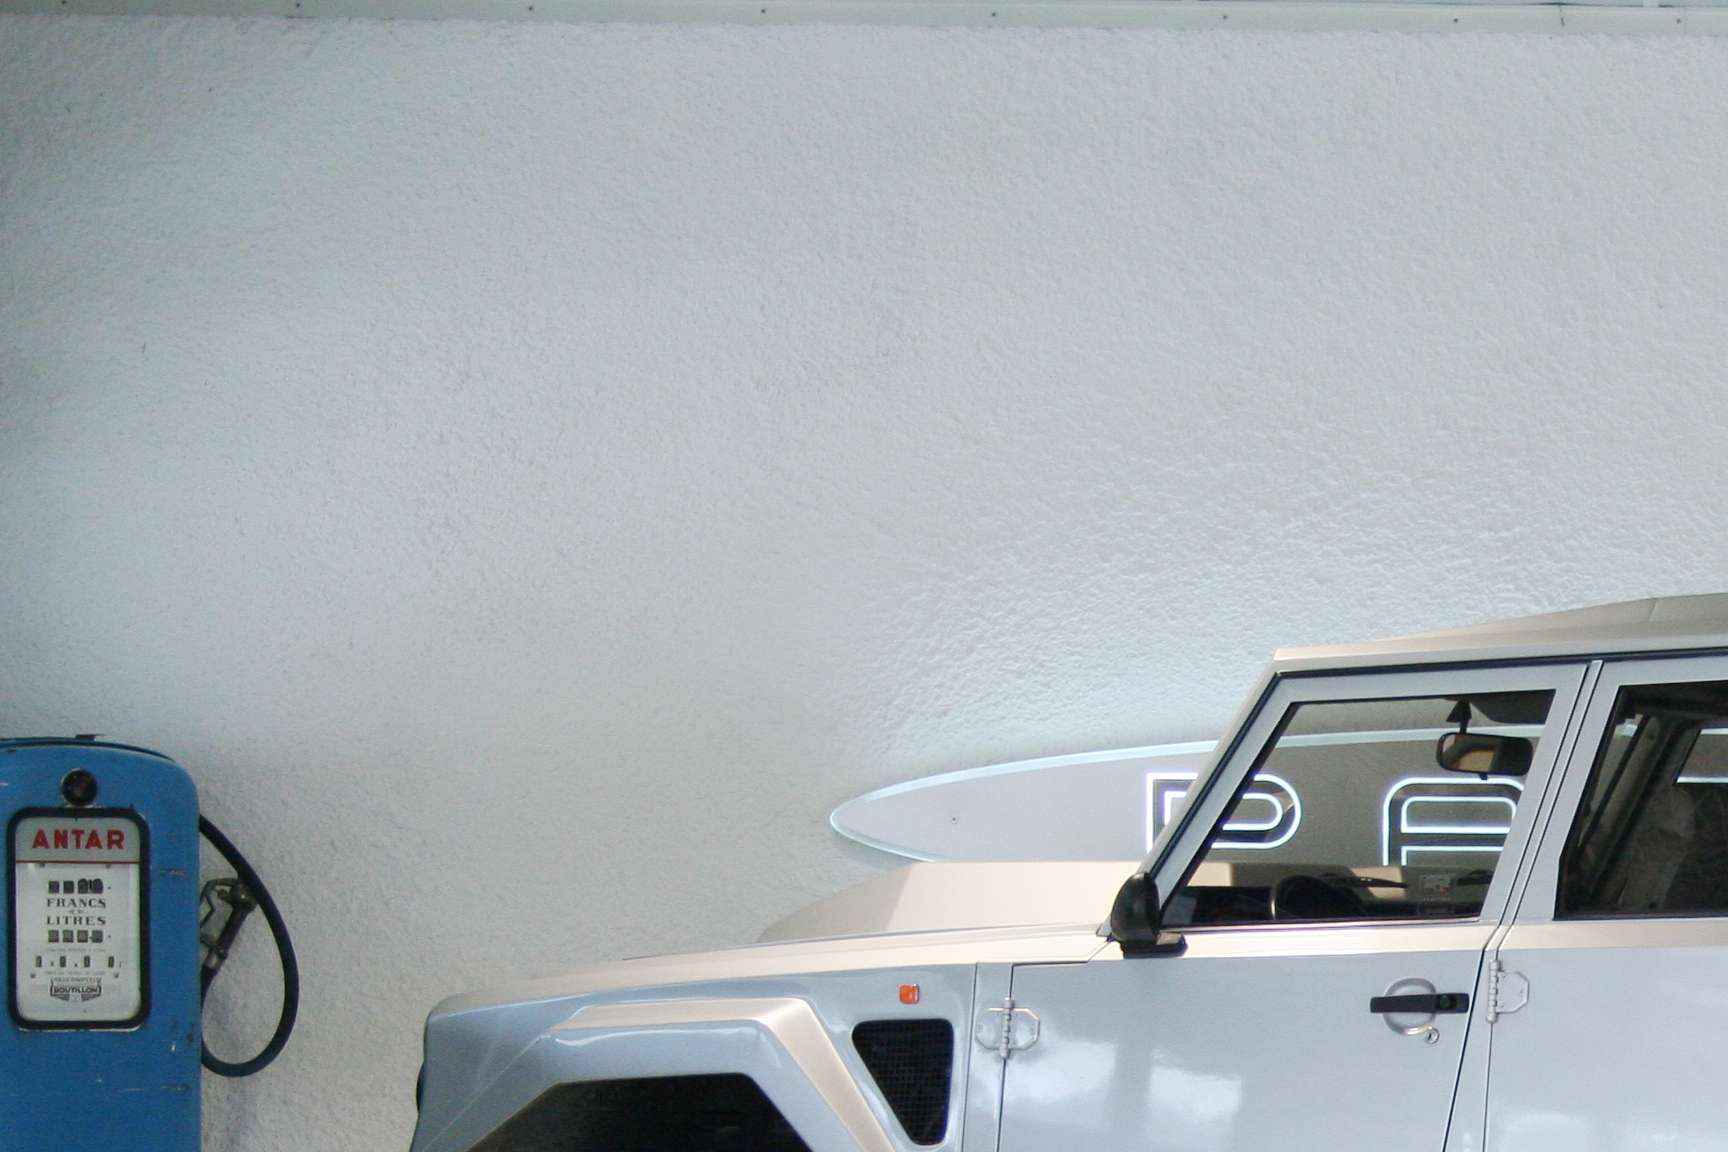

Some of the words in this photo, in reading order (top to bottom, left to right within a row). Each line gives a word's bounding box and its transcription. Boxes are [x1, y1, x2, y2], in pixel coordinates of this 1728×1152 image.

[32, 829, 125, 850] ANTAR
[46, 898, 107, 909] FRANCS
[46, 916, 107, 926] LITRES
